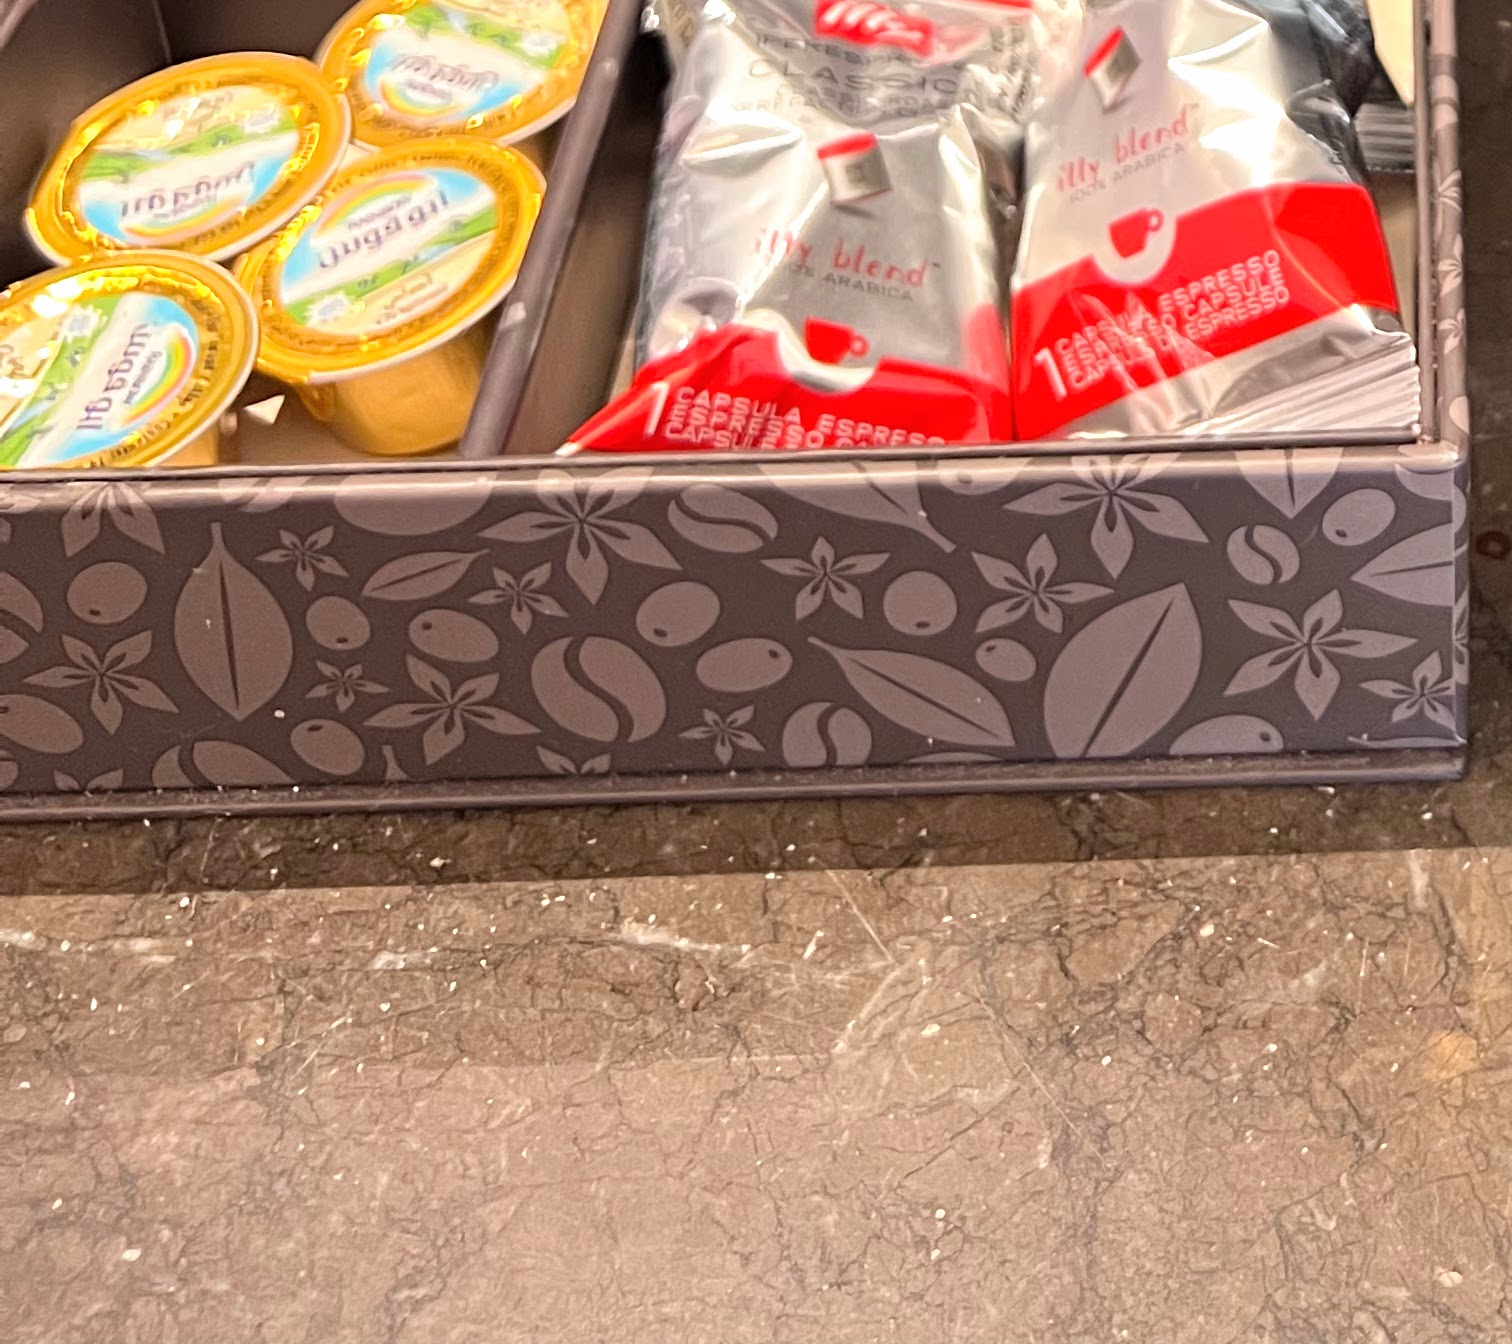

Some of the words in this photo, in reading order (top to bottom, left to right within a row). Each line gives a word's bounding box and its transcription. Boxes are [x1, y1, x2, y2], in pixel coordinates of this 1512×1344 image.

[1056, 156, 1100, 193] illy
[1112, 141, 1186, 183] ARABICA
[822, 269, 915, 303] ARABICA
[832, 238, 928, 288] blend
[1158, 249, 1281, 313] ESPRESSO
[1182, 265, 1285, 322] CAPSULE
[1184, 284, 1291, 345] ESPRESSO
[676, 385, 801, 424] CAPSULA
